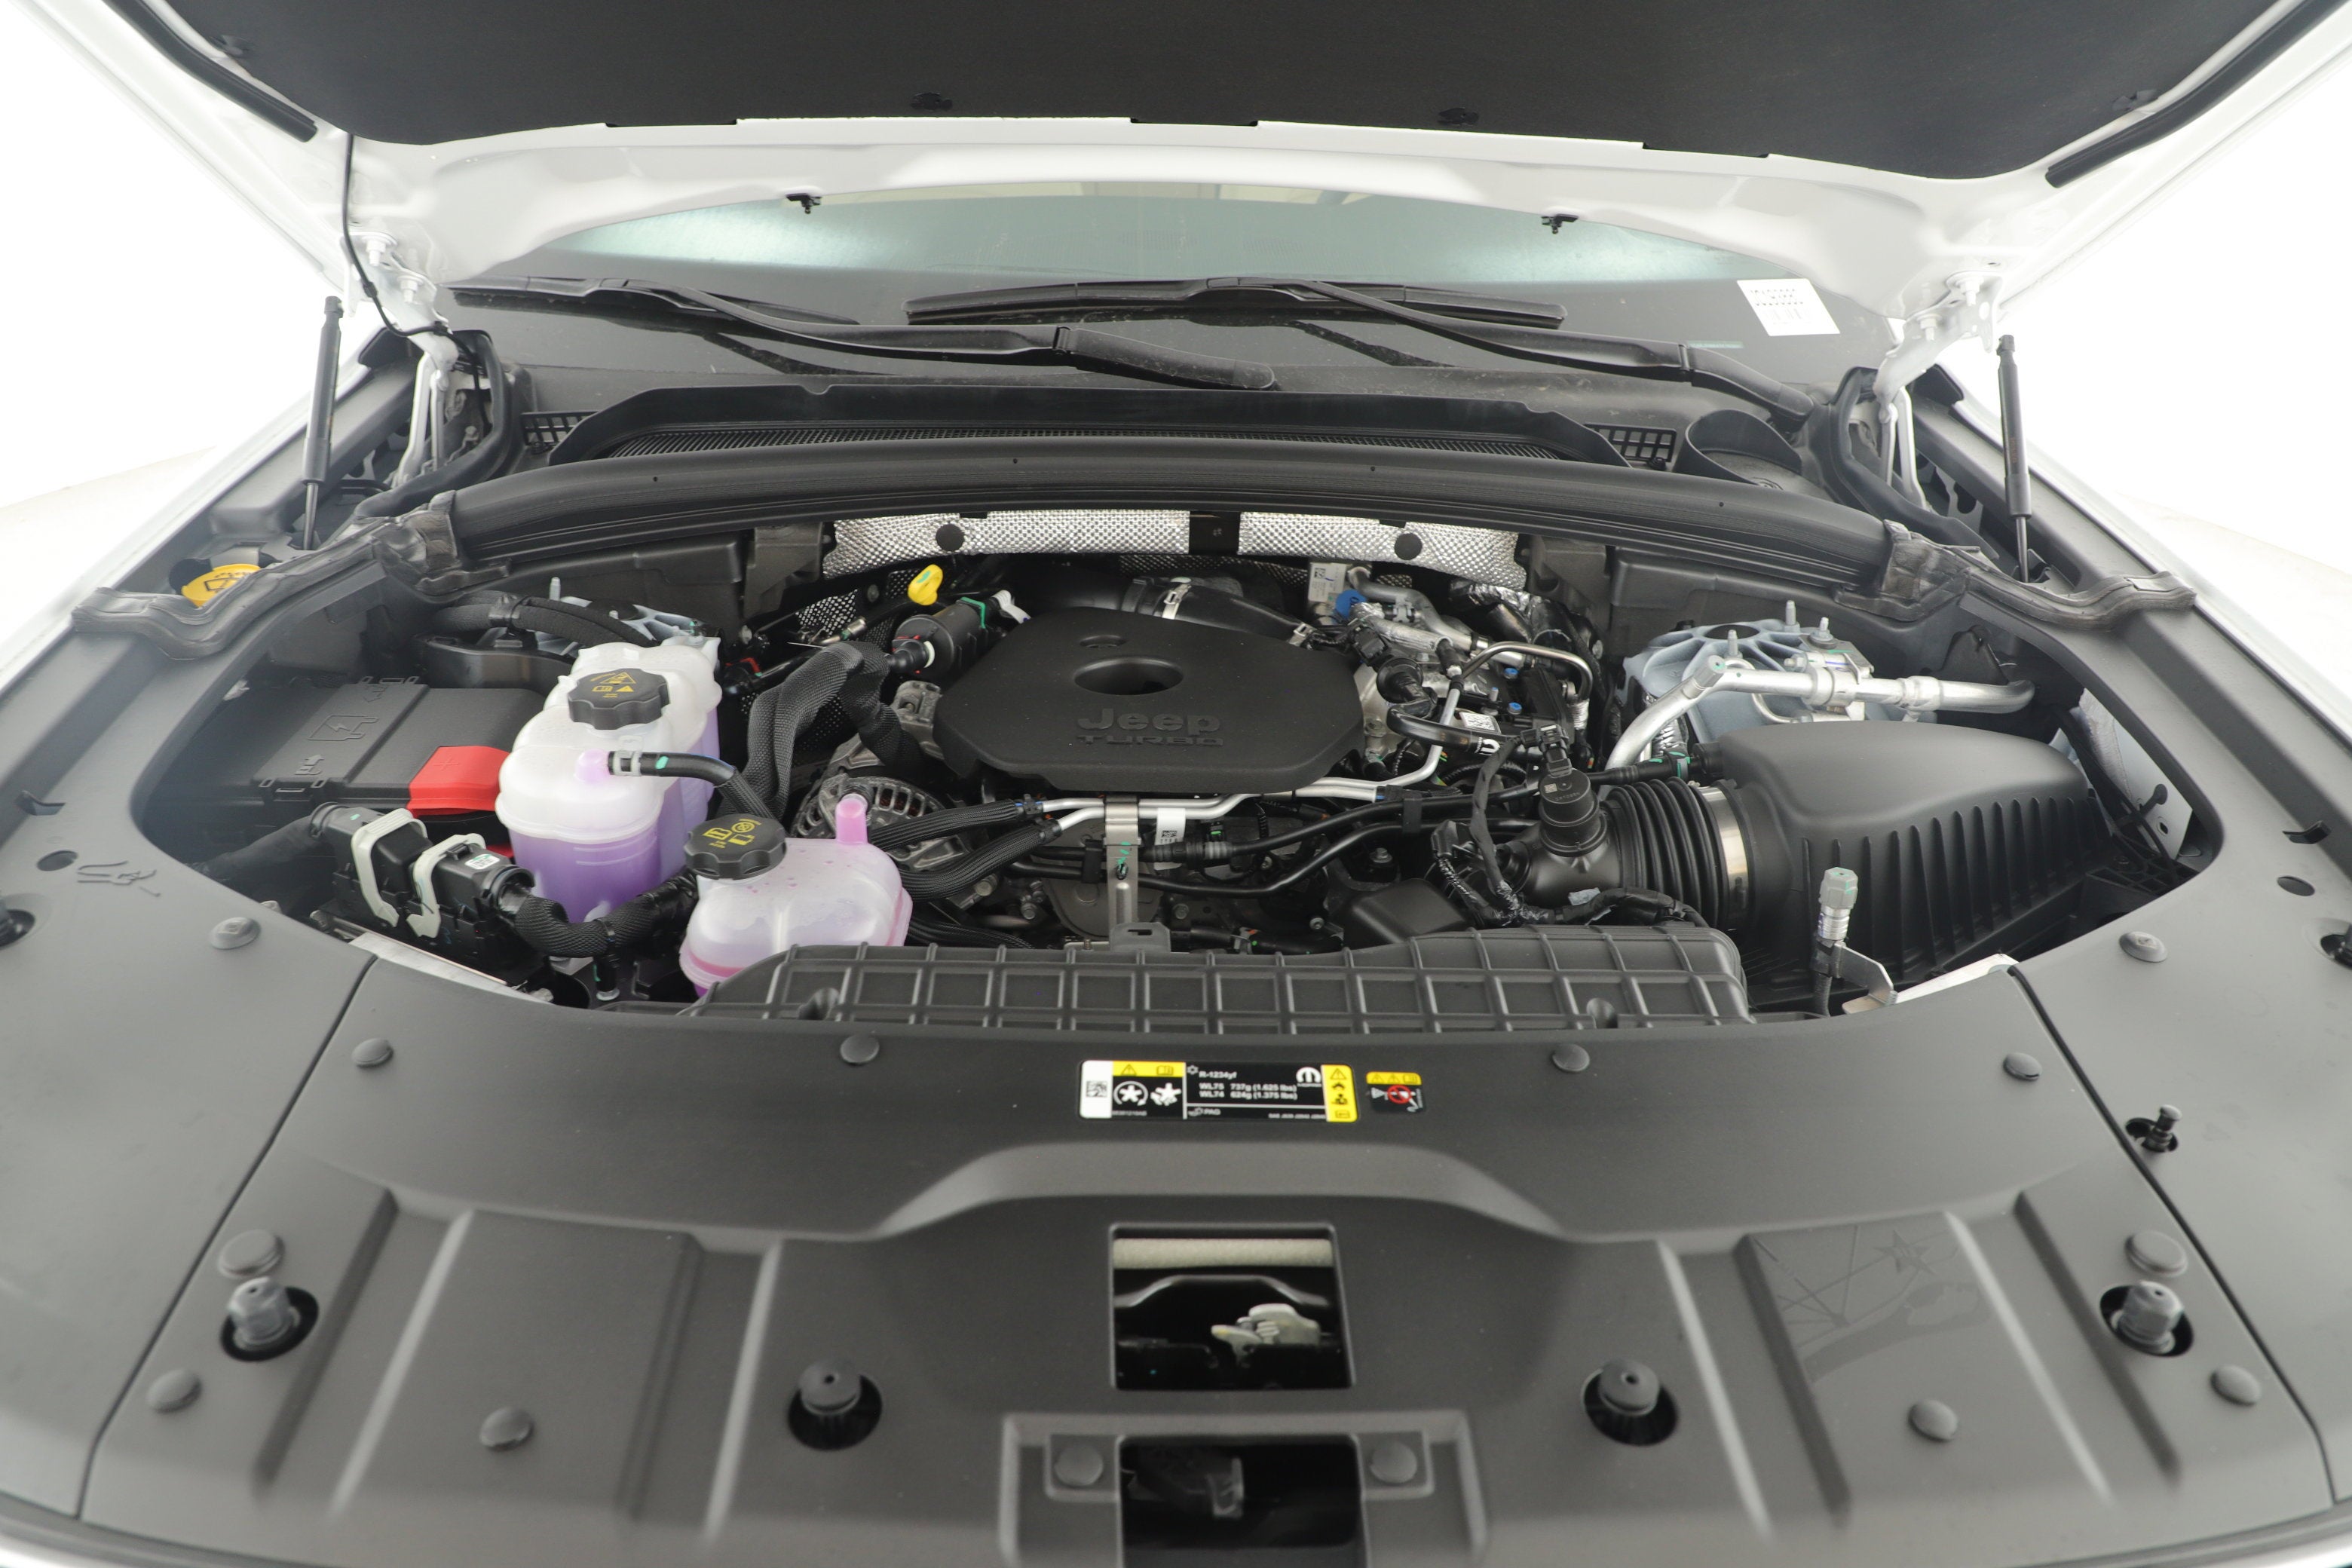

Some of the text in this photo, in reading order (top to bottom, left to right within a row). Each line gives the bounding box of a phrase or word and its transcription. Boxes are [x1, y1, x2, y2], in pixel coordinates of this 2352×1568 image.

[1077, 708, 1220, 736] Jeep
[1076, 735, 1223, 746] TURBO
[1199, 1070, 1237, 1080] R-1234yf
